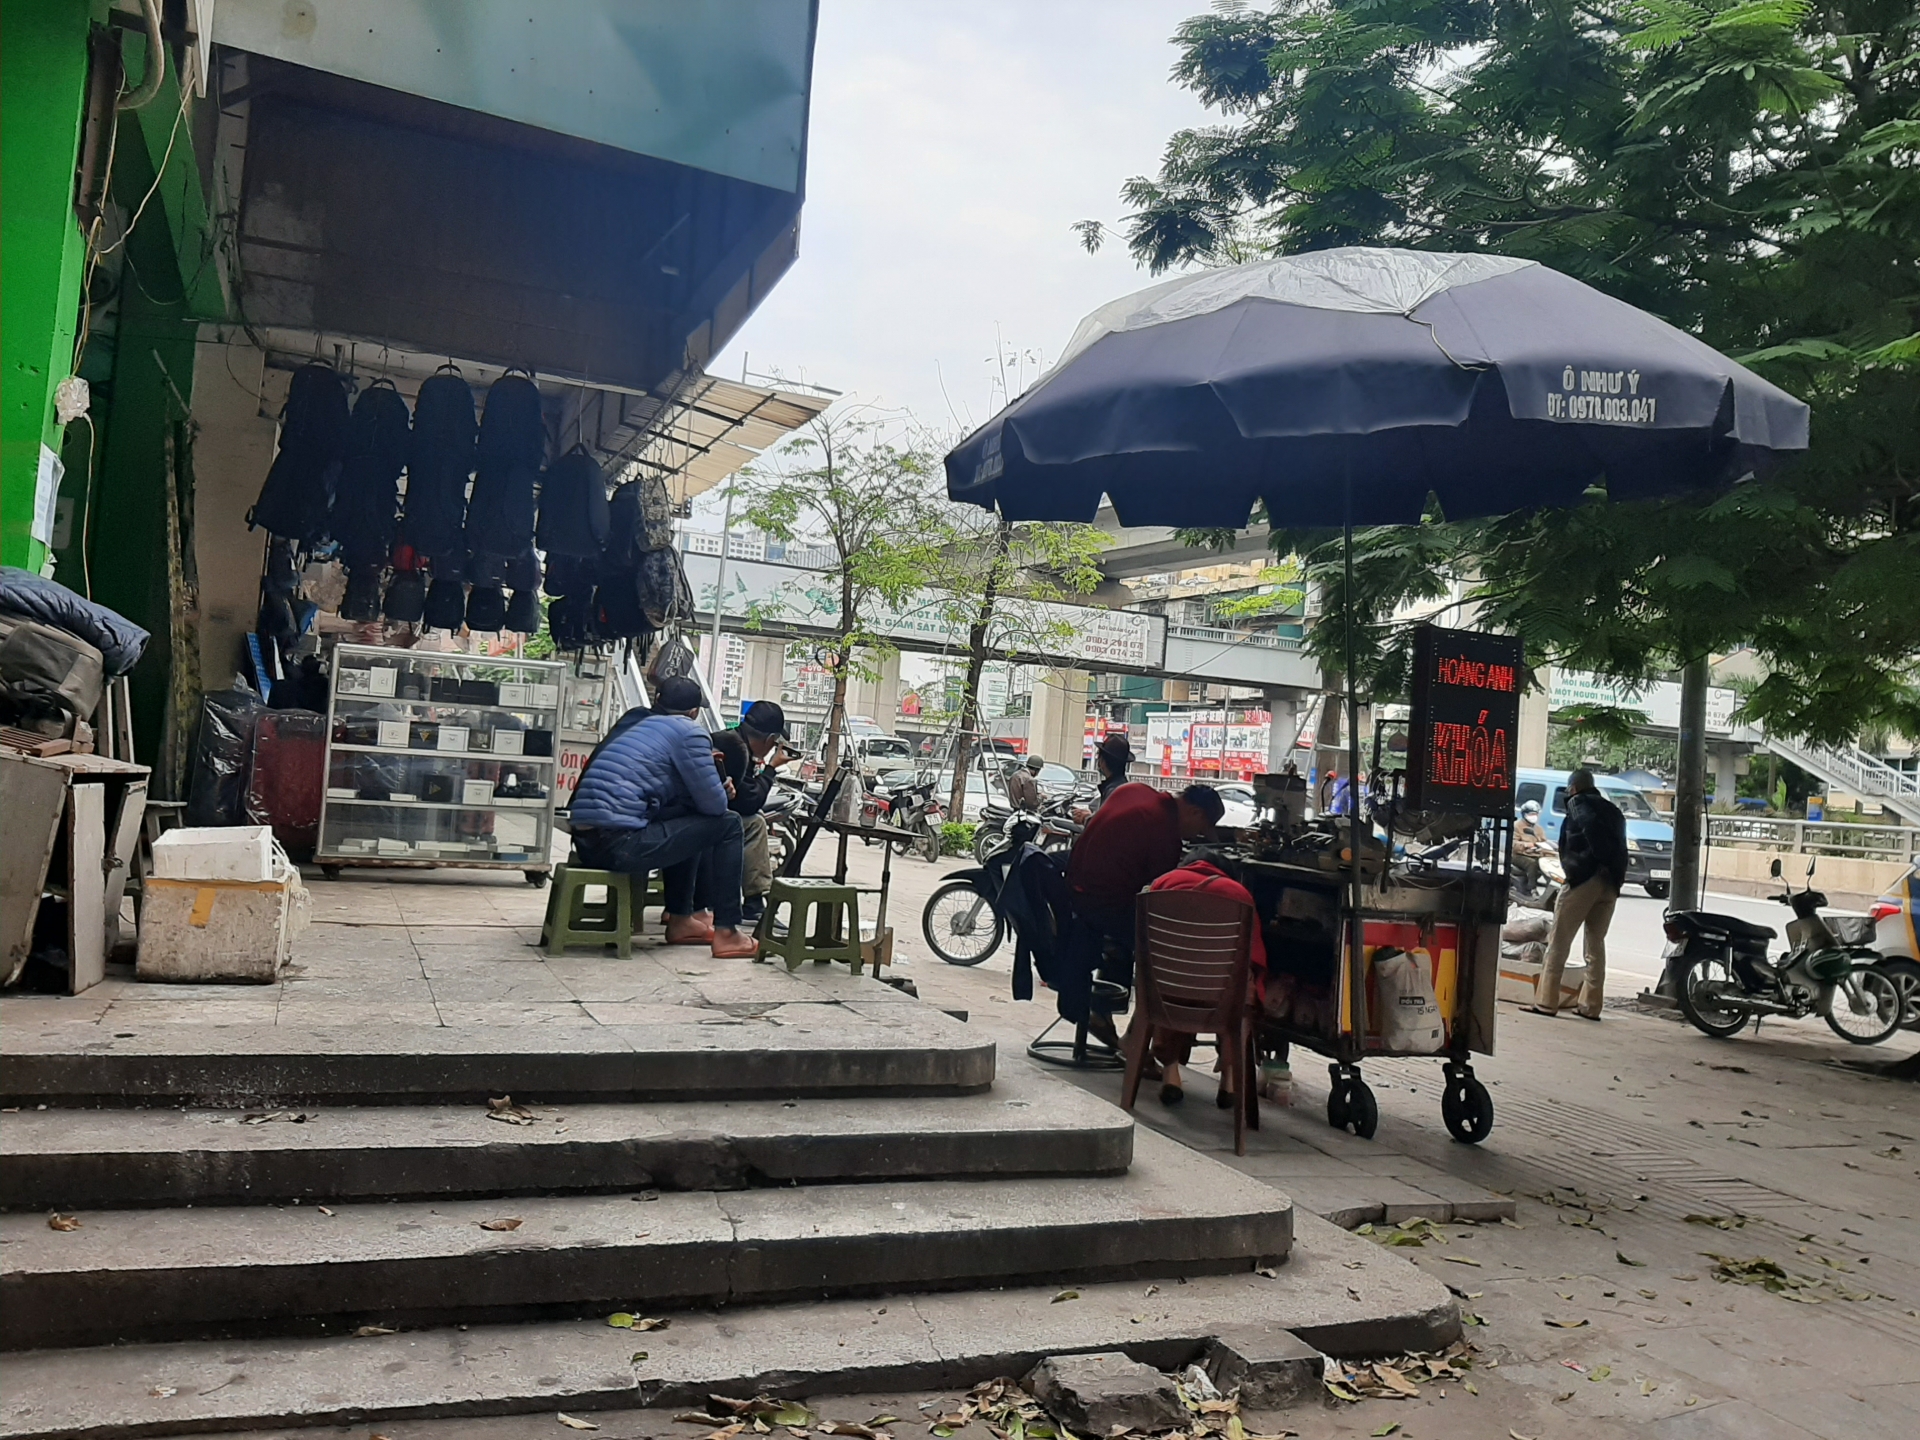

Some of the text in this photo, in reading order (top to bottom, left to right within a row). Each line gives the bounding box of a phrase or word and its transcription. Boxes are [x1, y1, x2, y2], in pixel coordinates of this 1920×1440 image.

[1563, 365, 1640, 394] Ô NHƯ Ý
[1438, 654, 1515, 692] HOÀNG ANH
[1431, 709, 1509, 789] KHÓA
